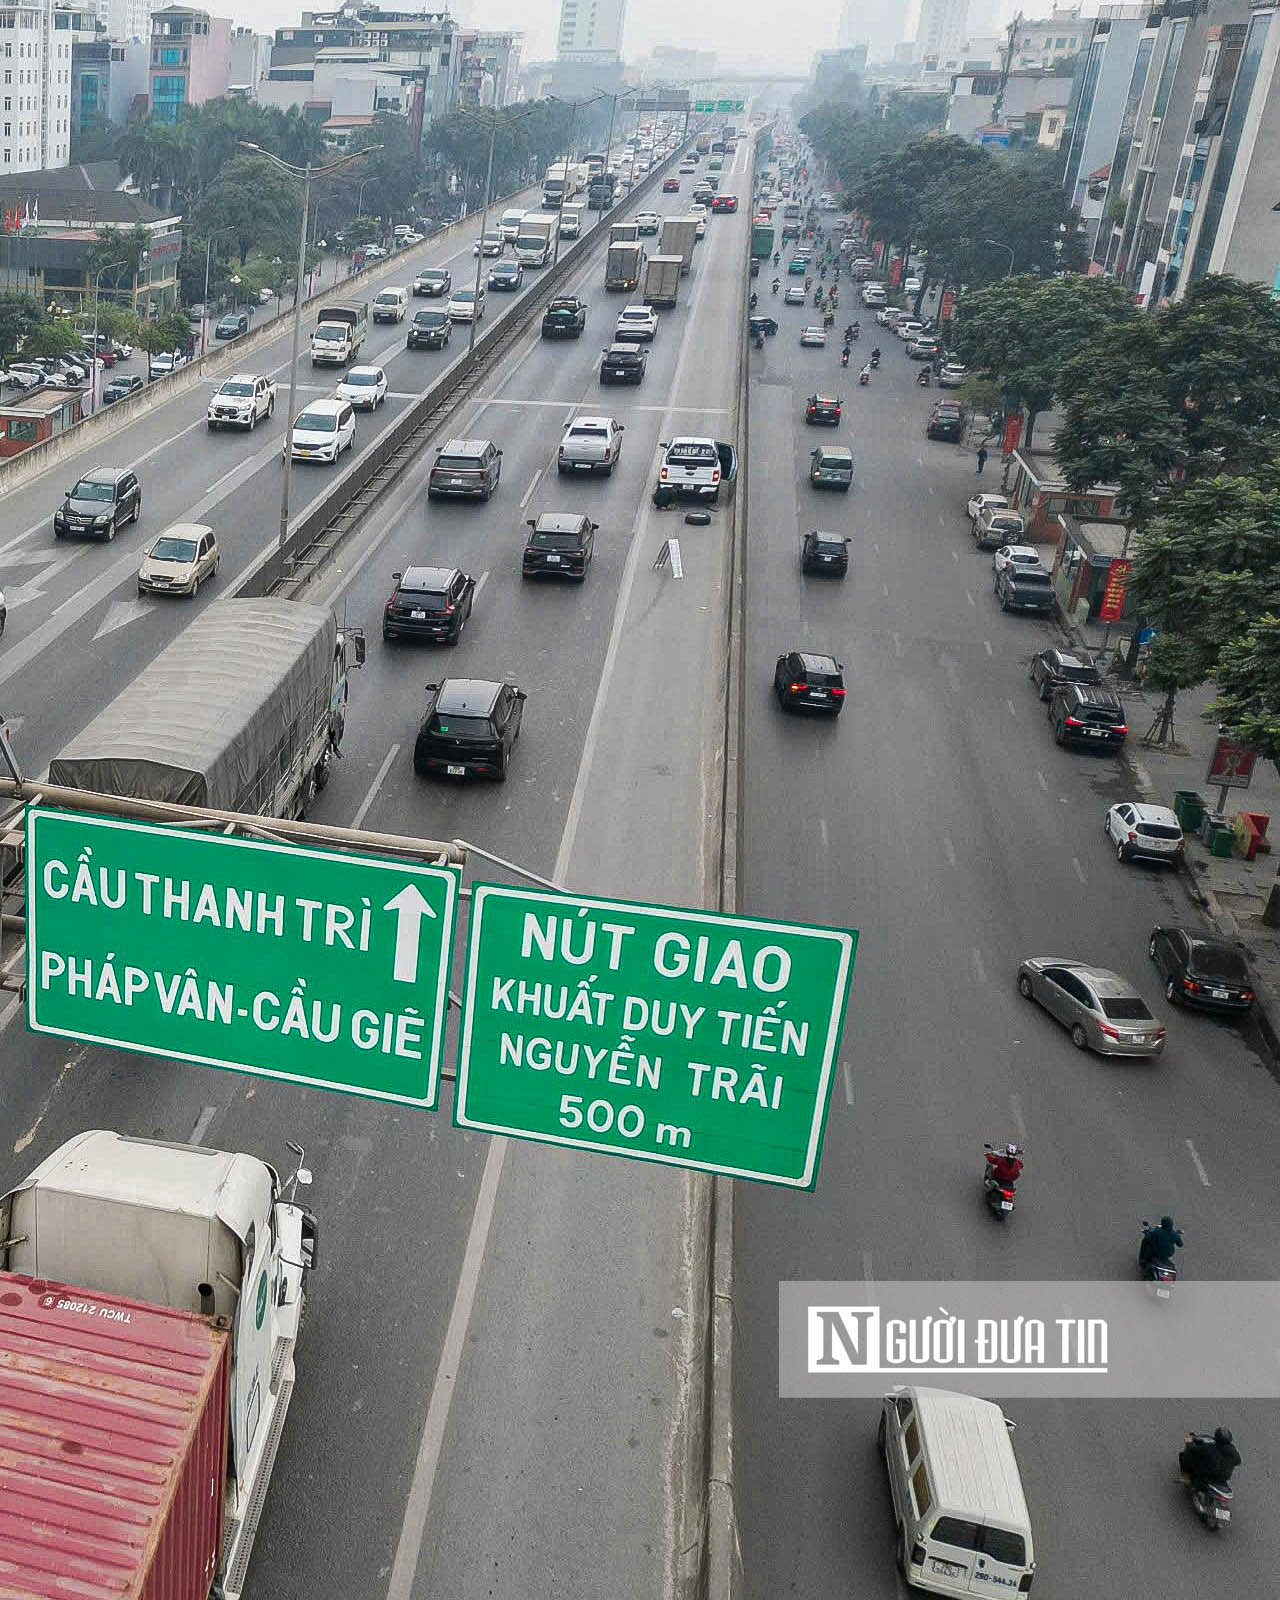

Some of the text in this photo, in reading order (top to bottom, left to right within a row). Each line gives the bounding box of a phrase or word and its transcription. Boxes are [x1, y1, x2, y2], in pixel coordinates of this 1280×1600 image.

[43, 846, 372, 952] CẦU THANH TRÌ
[521, 907, 792, 993] NÚT GIAO
[41, 951, 150, 1006] PHÁP
[351, 1007, 425, 1060] GIẼ
[491, 974, 809, 1057] KHUẤT DUY TIẾN
[500, 1032, 783, 1110] NGUYỄN TRÃI
[559, 1094, 691, 1148] 500 m
[56, 1299, 97, 1315] 212085
[99, 1308, 131, 1323] TWCU
